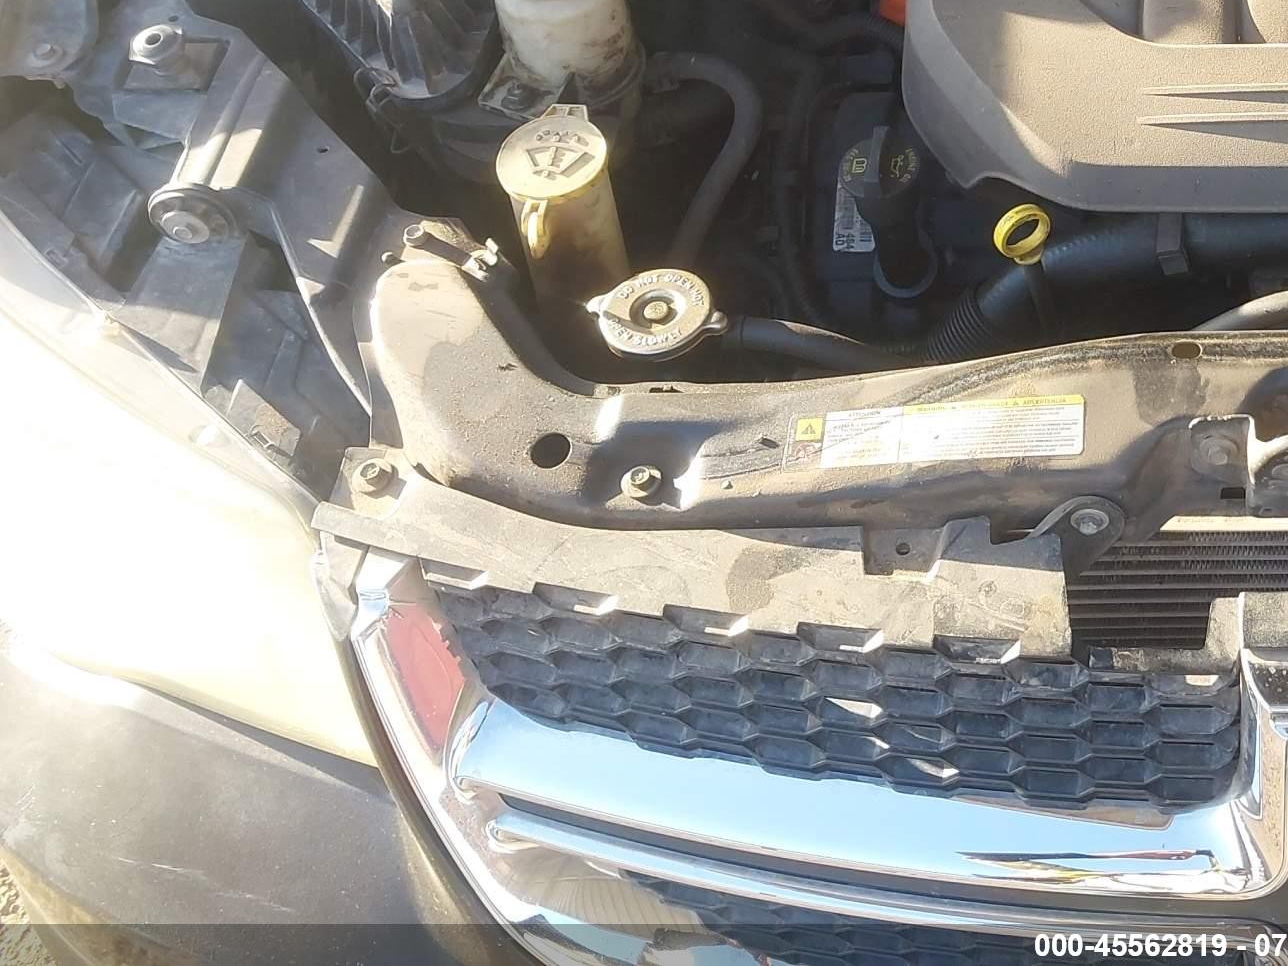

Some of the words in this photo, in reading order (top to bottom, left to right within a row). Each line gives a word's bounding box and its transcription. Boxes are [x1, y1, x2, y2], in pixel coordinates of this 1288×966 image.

[617, 285, 635, 300] DO
[635, 273, 661, 289] NOT
[663, 272, 694, 291] OPEN
[690, 286, 705, 307] HOT
[607, 317, 635, 343] OPEN
[633, 327, 683, 346] SLOWLY
